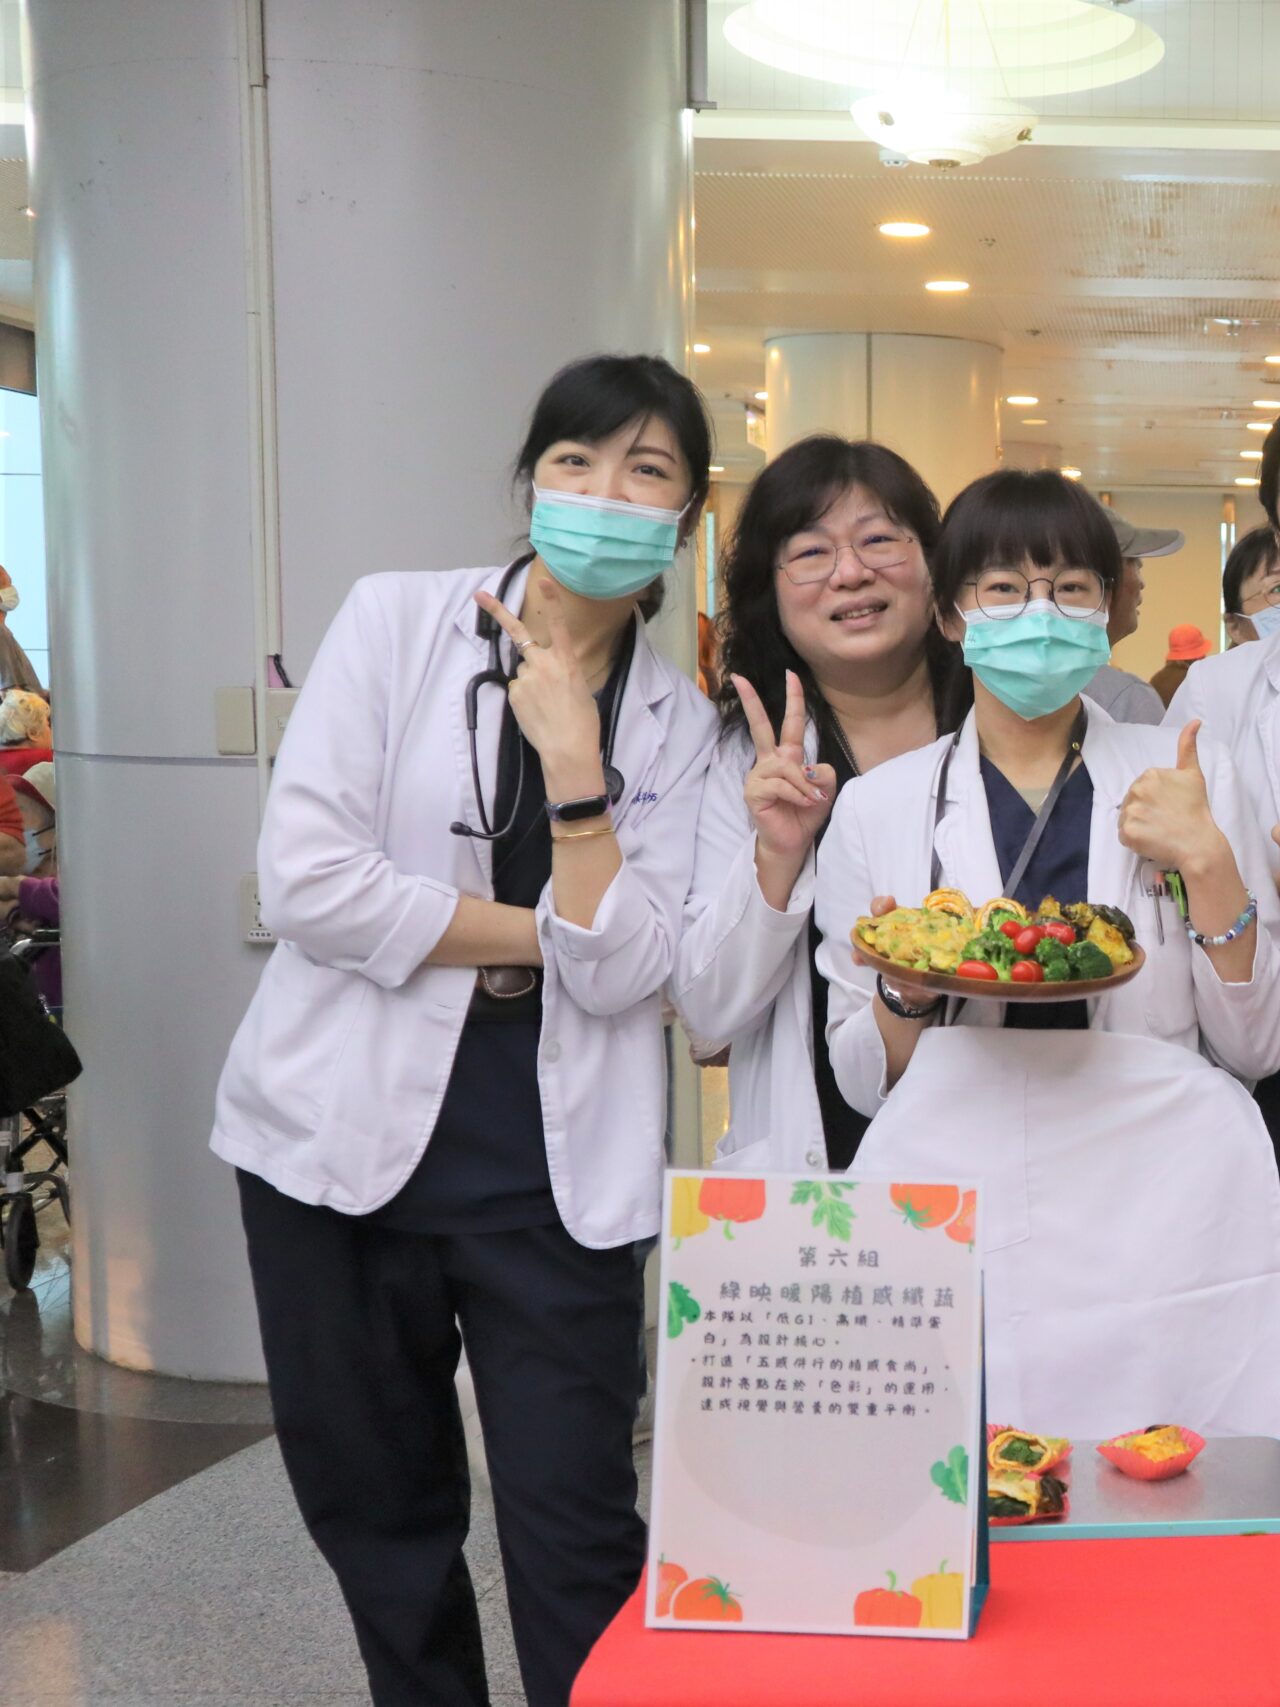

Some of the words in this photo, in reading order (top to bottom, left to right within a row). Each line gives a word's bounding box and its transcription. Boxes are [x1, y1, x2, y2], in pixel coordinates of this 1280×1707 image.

[799, 1246, 880, 1268] 第六組
[720, 1280, 954, 1308] 綠映暖陽植感纖蔬
